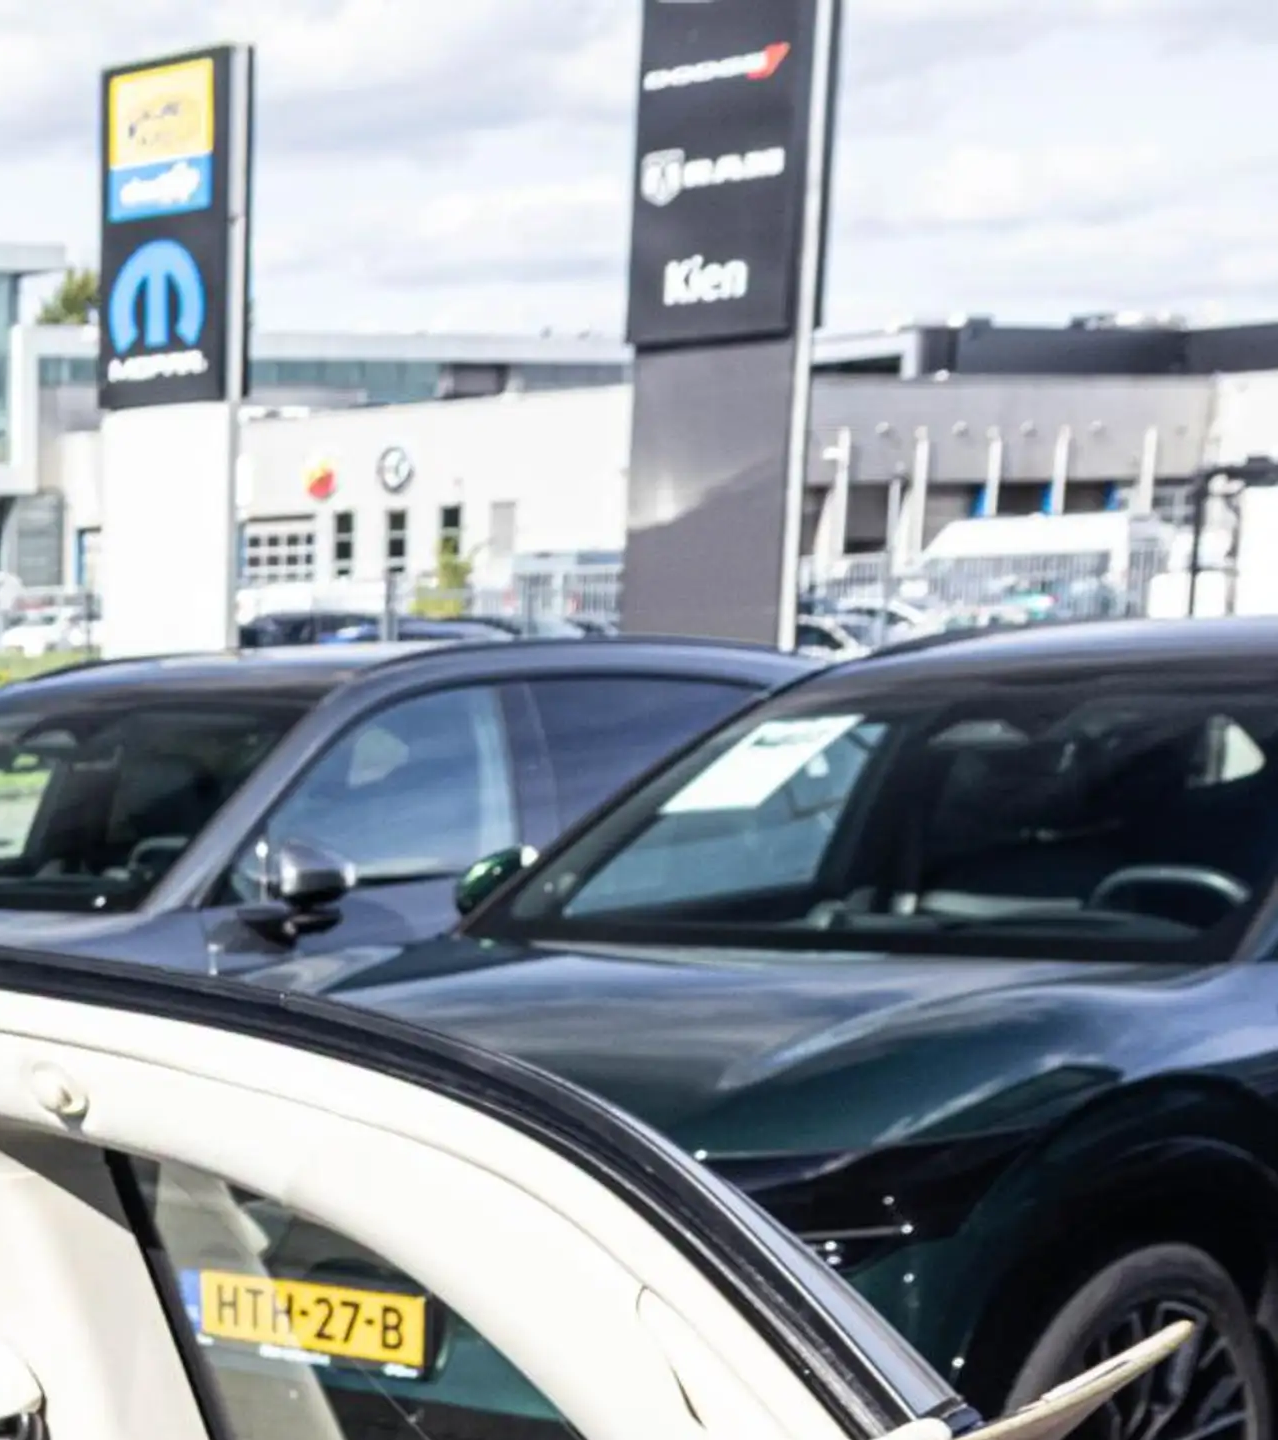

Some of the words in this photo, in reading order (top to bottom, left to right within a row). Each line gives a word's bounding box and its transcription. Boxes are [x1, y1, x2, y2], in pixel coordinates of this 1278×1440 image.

[683, 148, 786, 190] RAM
[664, 254, 748, 306] Kien
[216, 1284, 404, 1350] HTH-27-B
